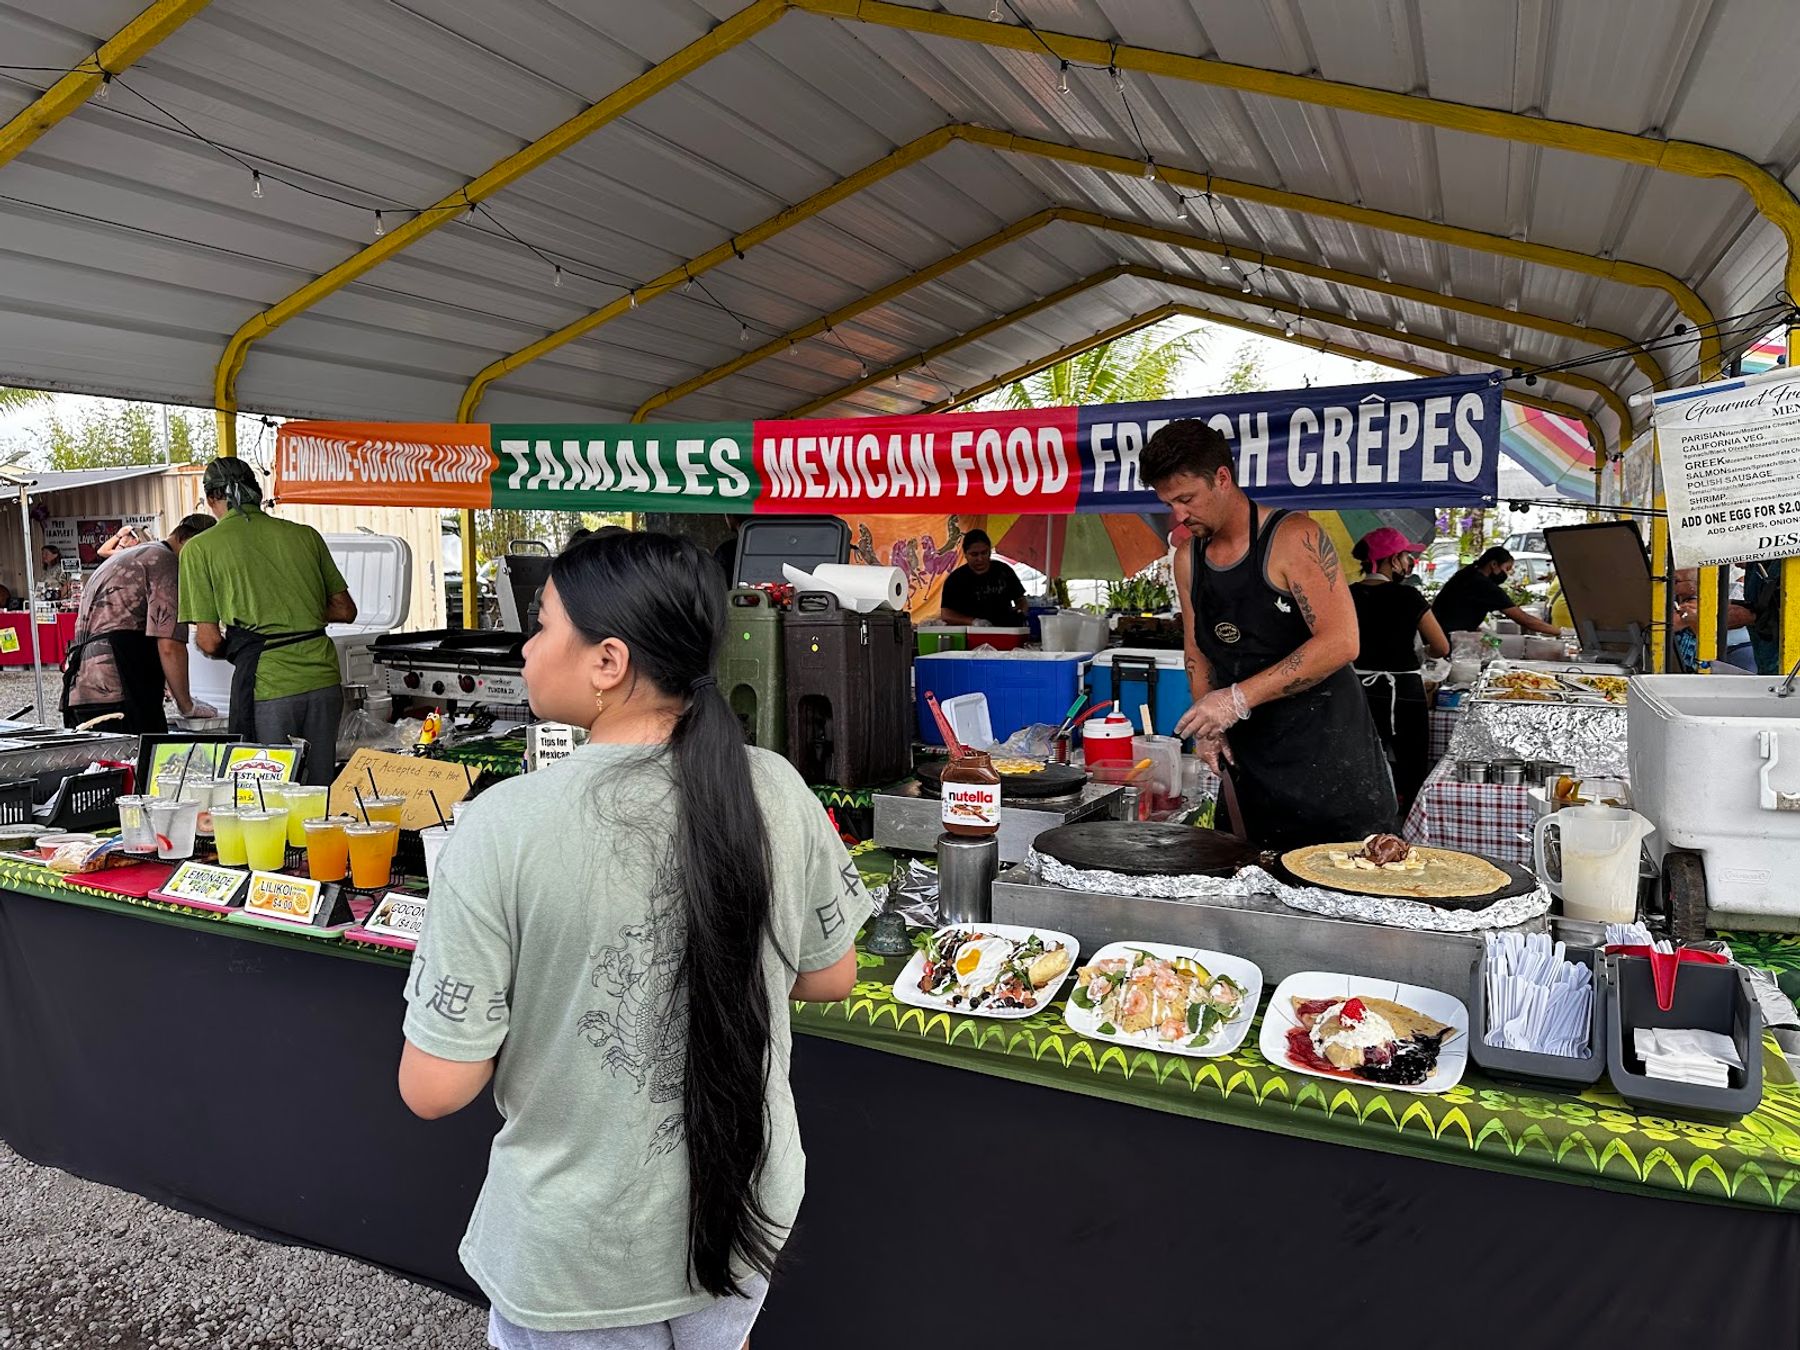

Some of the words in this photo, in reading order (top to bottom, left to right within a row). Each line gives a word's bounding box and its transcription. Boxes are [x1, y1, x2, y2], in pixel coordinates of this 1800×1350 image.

[1685, 389, 1768, 422] Gourmet
[501, 437, 750, 497] TAMALES
[763, 434, 941, 498] MEXICAN
[951, 427, 1069, 496] FOOD
[1090, 411, 1269, 493] FRCH
[1287, 393, 1484, 487] CRÊPES
[1682, 437, 1741, 453] CALIFORNIA
[1684, 456, 1726, 471] GREEK
[1686, 467, 1727, 481] SALMON
[1687, 478, 1723, 490] POLISH
[1724, 470, 1773, 484] SAUSAGE
[1681, 516, 1702, 529] ADD
[1704, 511, 1727, 525] ONE
[1729, 507, 1752, 521] EGG
[1754, 504, 1776, 518] FOR
[1707, 528, 1726, 536] ADD
[1769, 516, 1800, 527] ONION
[1697, 552, 1766, 567] STRAWBERRY
[540, 737, 556, 749] Tips
[557, 737, 568, 746] for
[539, 750, 571, 760] Mexican
[379, 759, 423, 777] Accepted
[259, 772, 283, 781] MENU
[948, 790, 993, 803] nutella
[183, 868, 234, 887] LEMONADE
[260, 880, 293, 896] LILIKOI
[273, 898, 293, 910] $4.00
